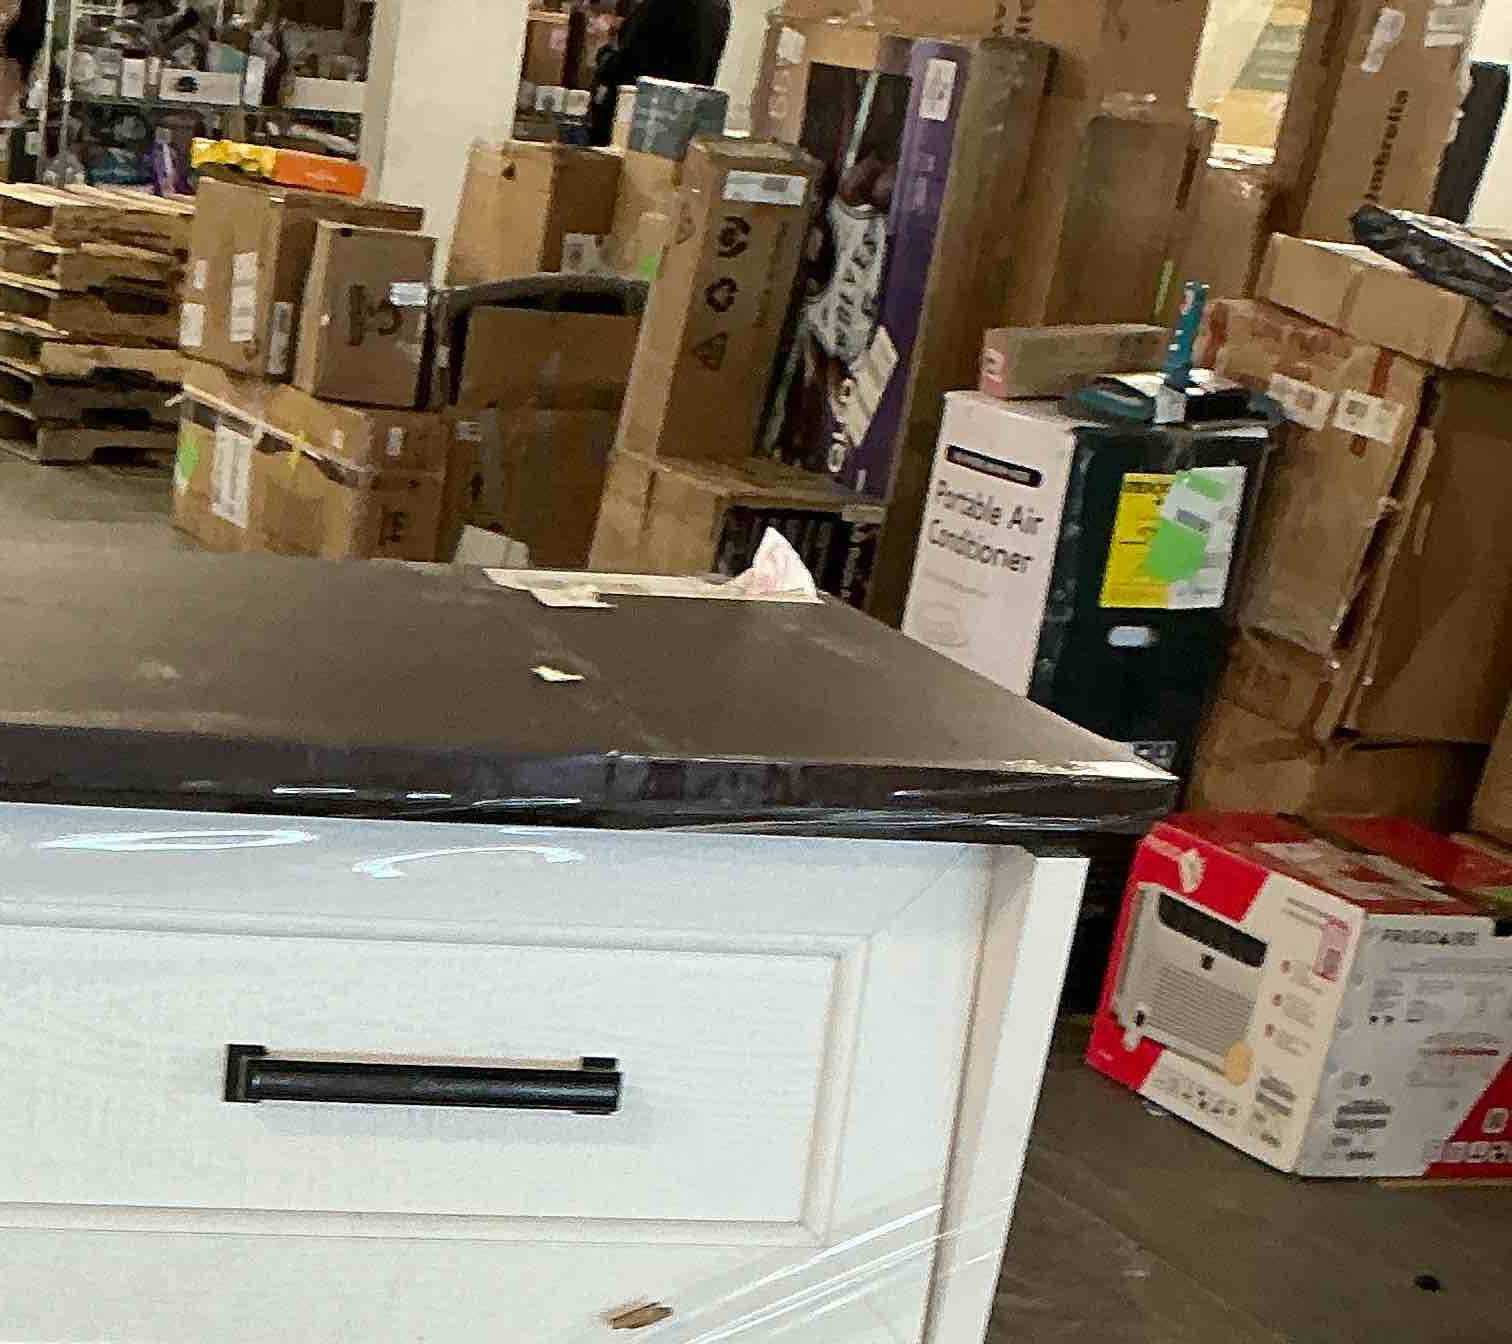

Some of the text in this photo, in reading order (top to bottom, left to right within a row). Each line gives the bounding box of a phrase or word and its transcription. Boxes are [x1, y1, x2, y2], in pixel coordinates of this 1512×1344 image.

[935, 479, 1044, 535] Portable Air
[928, 518, 1034, 574] Conditioner
